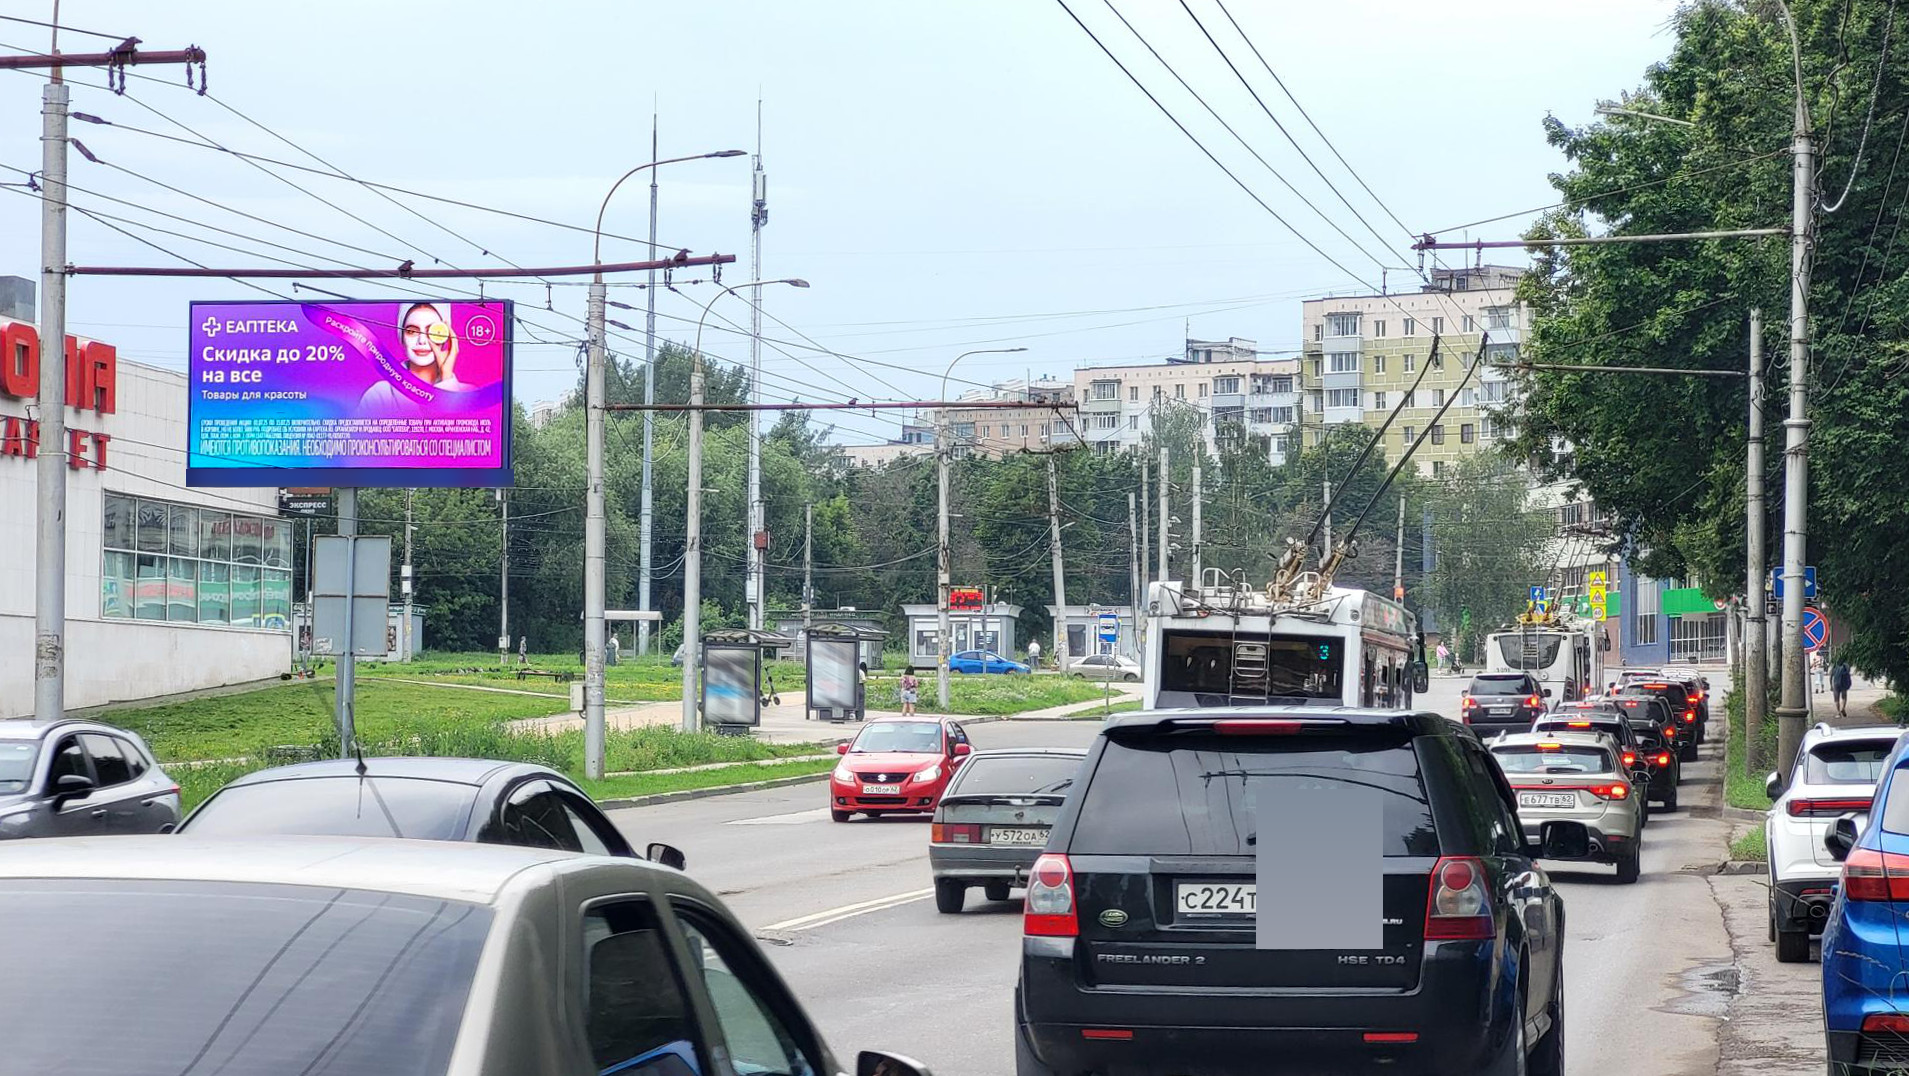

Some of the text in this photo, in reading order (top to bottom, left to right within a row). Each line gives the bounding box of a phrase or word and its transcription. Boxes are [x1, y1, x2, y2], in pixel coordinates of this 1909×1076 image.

[226, 320, 299, 333] ЕАПТЕКА
[470, 325, 491, 337] 18+
[202, 345, 345, 363] Скидка до 20%
[325, 316, 435, 402] Раскройте природную красоту
[202, 369, 263, 383] на все
[201, 389, 307, 402] Товары для красоты
[289, 501, 327, 509] ЭКСПРЕСС
[1319, 644, 1329, 660] 3
[1185, 887, 1256, 909] С224Т
[1097, 954, 1206, 965] FREELANDER 2
[1338, 955, 1406, 965] HSE TD4
